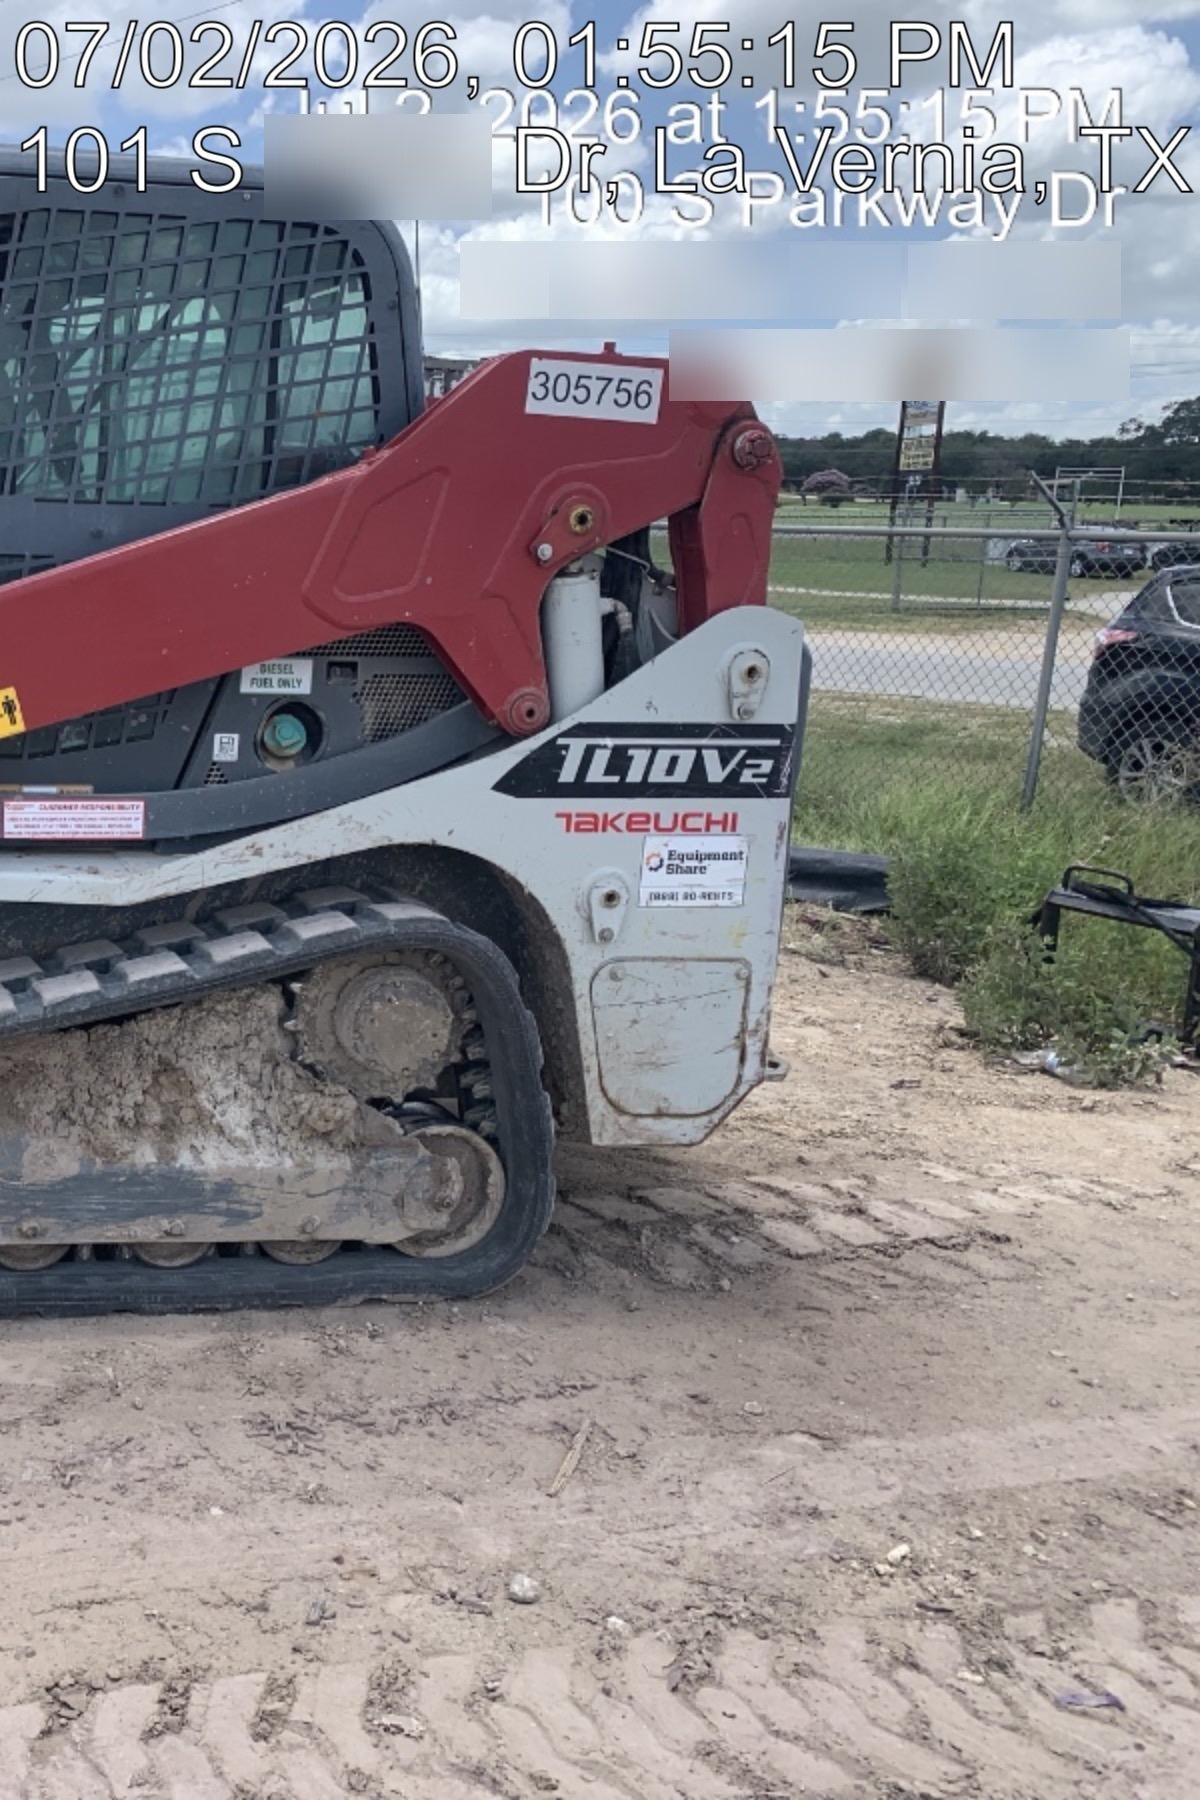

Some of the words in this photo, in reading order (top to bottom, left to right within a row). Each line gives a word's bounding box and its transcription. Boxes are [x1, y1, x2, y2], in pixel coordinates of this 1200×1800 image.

[531, 371, 654, 411] 305756
[259, 663, 294, 675] DIESEL
[250, 677, 275, 689] FUEL
[277, 678, 303, 689] ONLY
[666, 849, 745, 864] Equipment
[665, 863, 708, 875] Share
